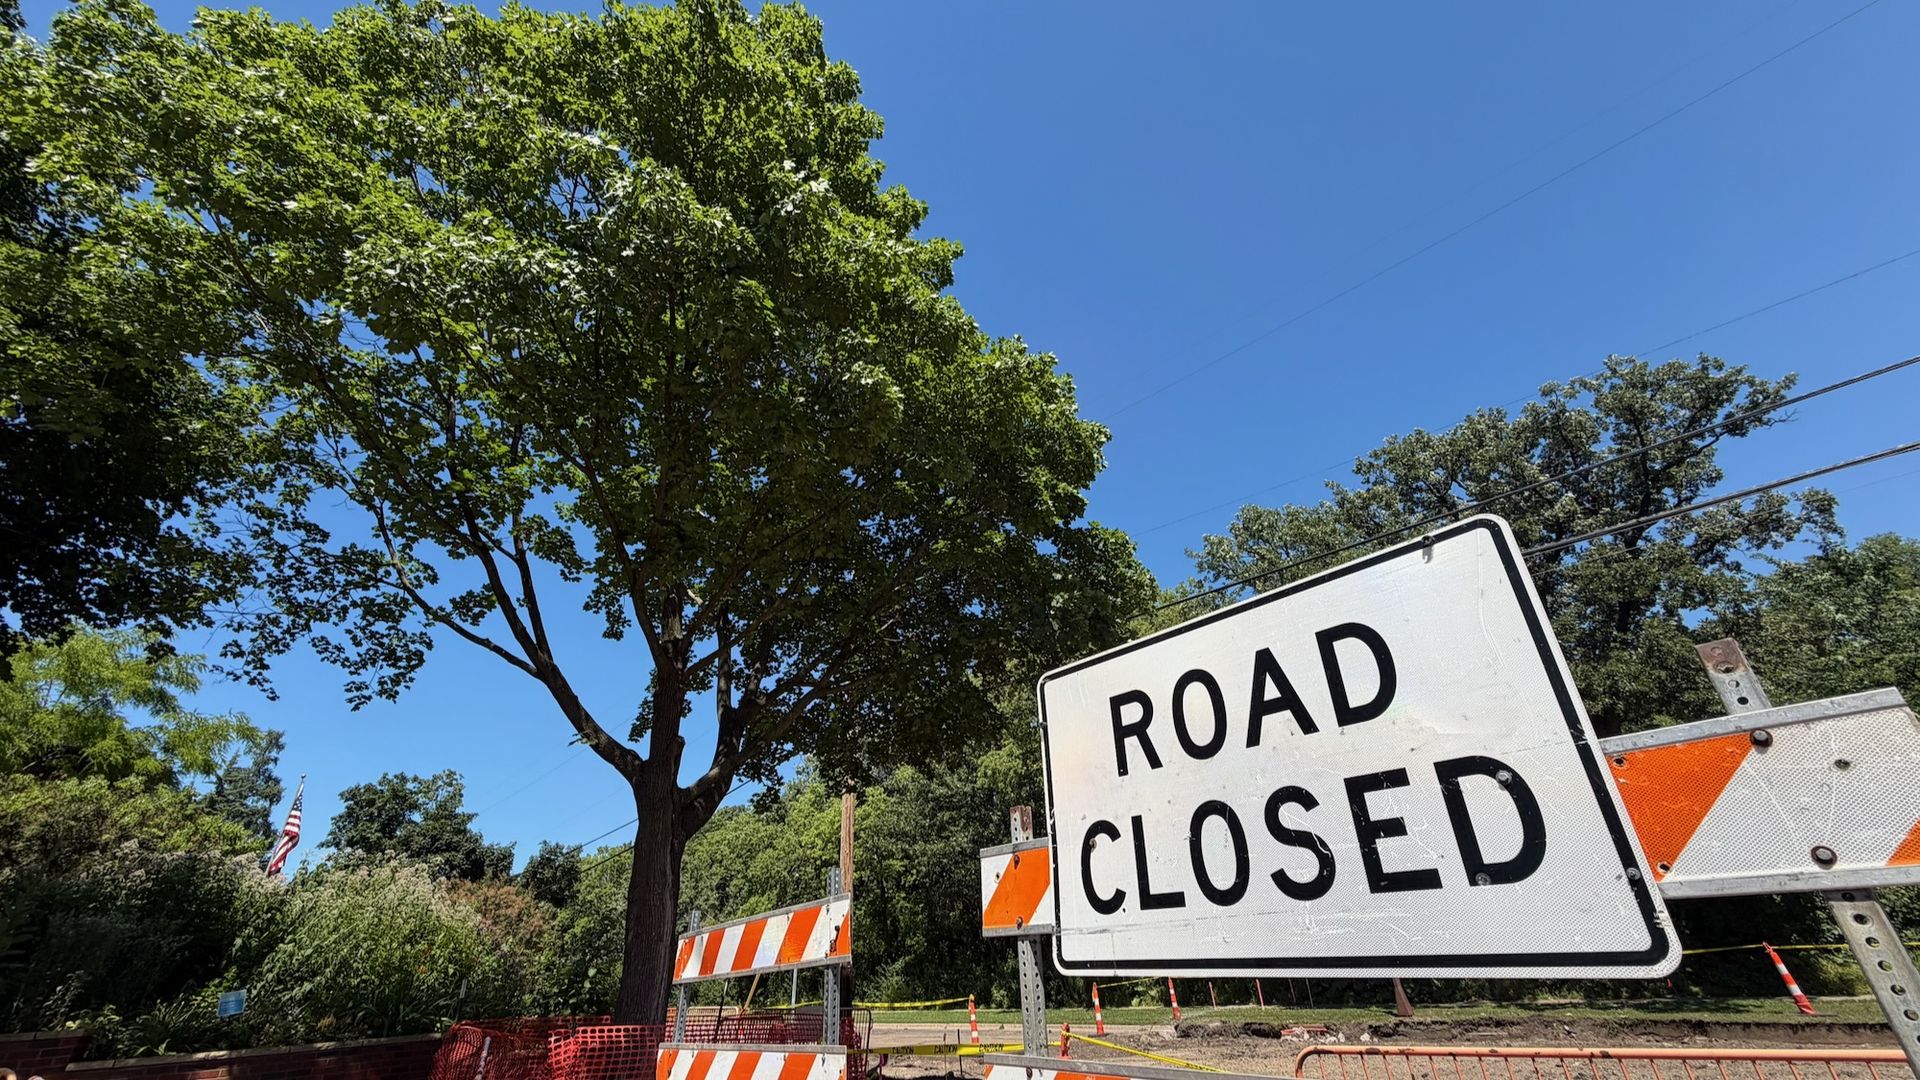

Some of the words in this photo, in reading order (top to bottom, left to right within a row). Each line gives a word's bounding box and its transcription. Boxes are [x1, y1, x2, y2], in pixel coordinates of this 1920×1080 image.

[1109, 622, 1397, 777] ROAD
[1080, 755, 1547, 915] CLOSED
[892, 1046, 914, 1055] CAUTION
[934, 1044, 958, 1054] CAUTION
